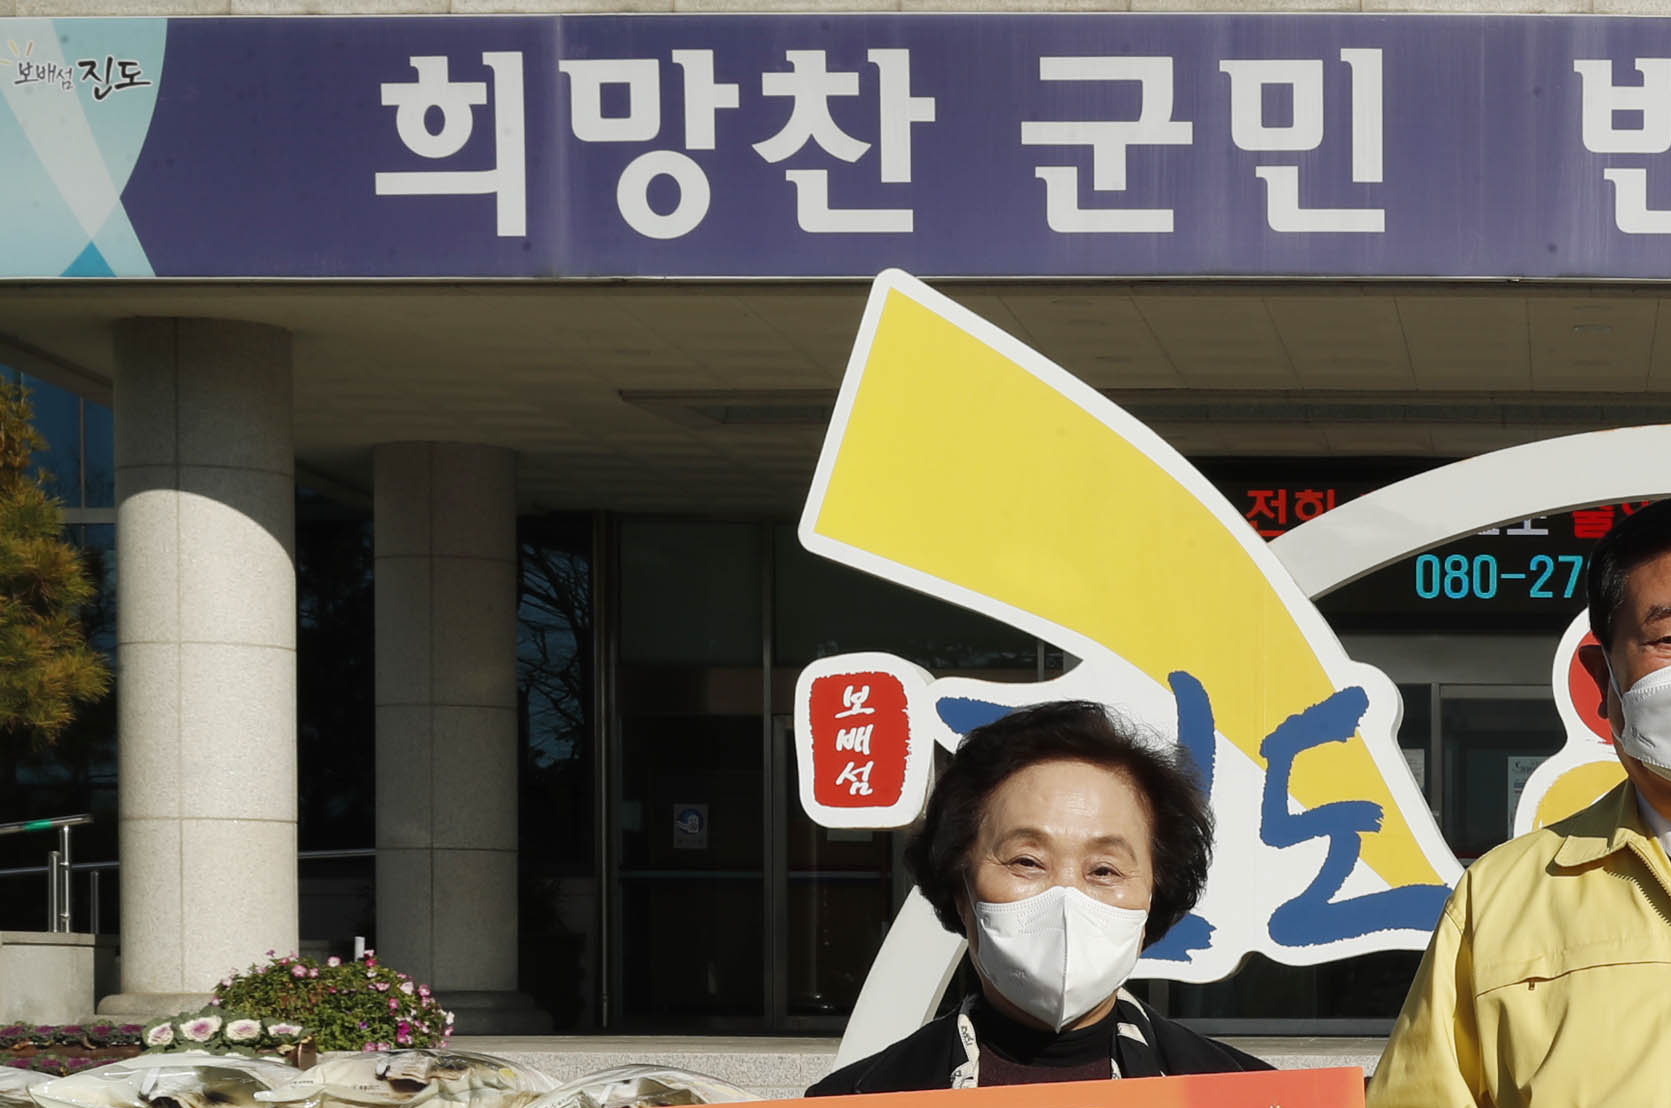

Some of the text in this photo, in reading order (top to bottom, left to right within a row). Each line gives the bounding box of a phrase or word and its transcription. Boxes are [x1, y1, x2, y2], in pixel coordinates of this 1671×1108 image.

[14, 56, 152, 101] 보배섬 진도
[375, 48, 936, 239] 희망찬
[1021, 48, 1386, 233] 군민
[1415, 553, 1592, 600] 080-27
[834, 684, 876, 796] 보배섬
